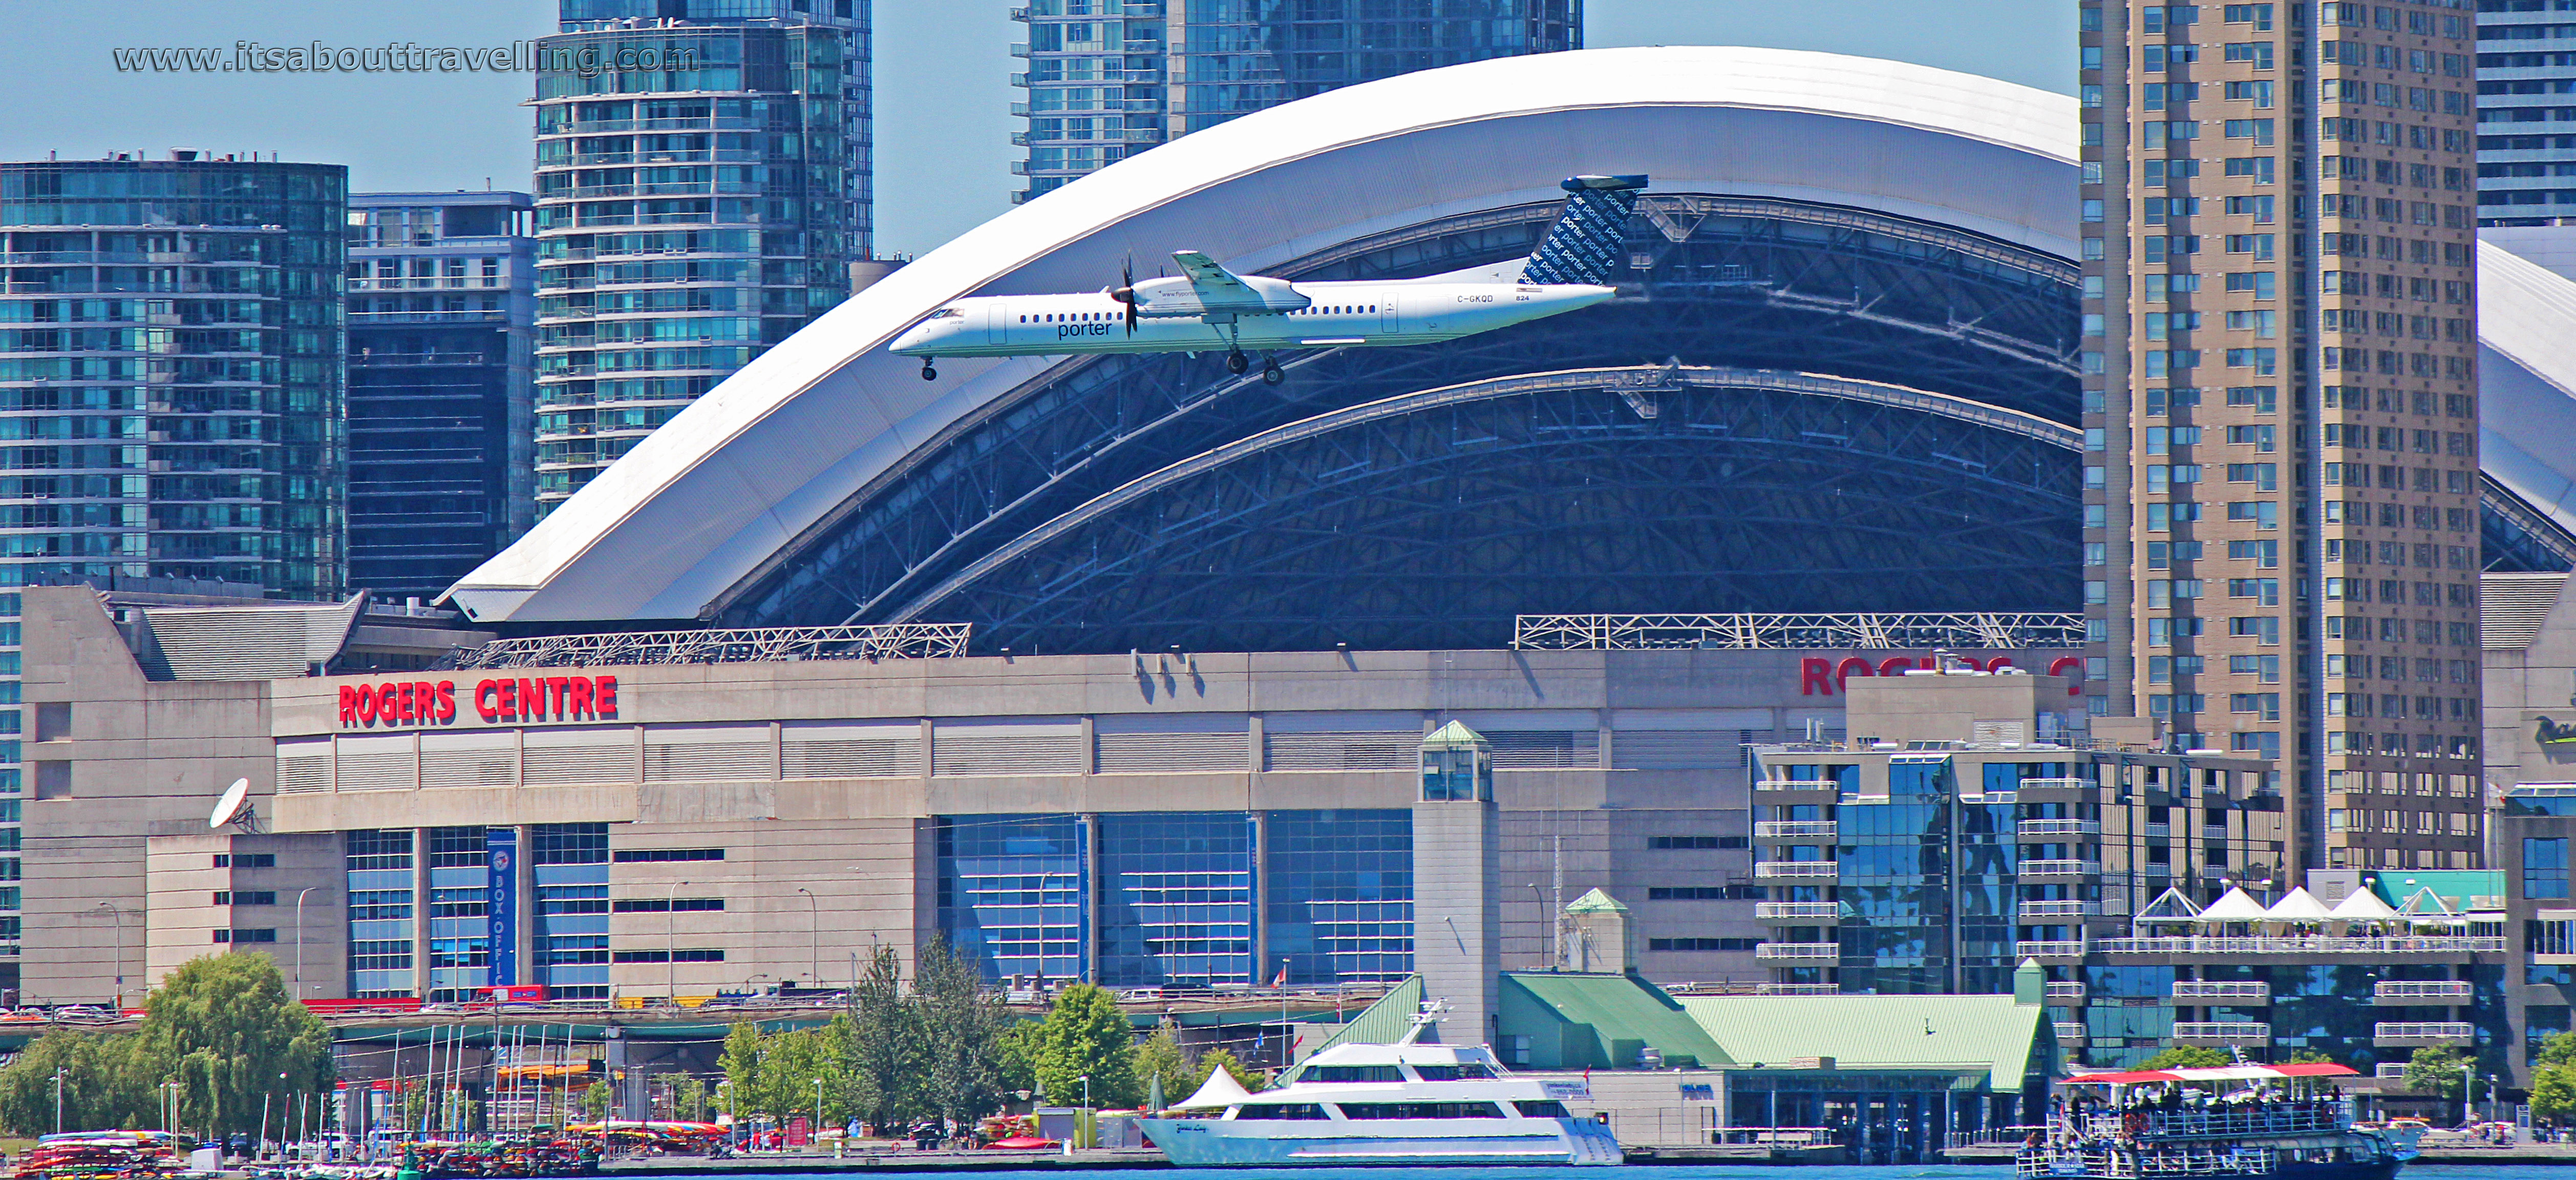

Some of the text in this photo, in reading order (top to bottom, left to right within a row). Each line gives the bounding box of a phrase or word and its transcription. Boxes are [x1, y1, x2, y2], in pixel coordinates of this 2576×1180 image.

[1582, 205, 1608, 227] porter
[1561, 216, 1586, 239] porter
[1583, 238, 1609, 260] porter
[1583, 221, 1608, 243] porter
[1561, 233, 1586, 255] porter
[1583, 255, 1609, 276] porter
[1561, 249, 1587, 271] porter
[1540, 261, 1565, 283] porter
[1058, 321, 1113, 341] porter
[339, 676, 615, 722] ROGERS CENTRE
